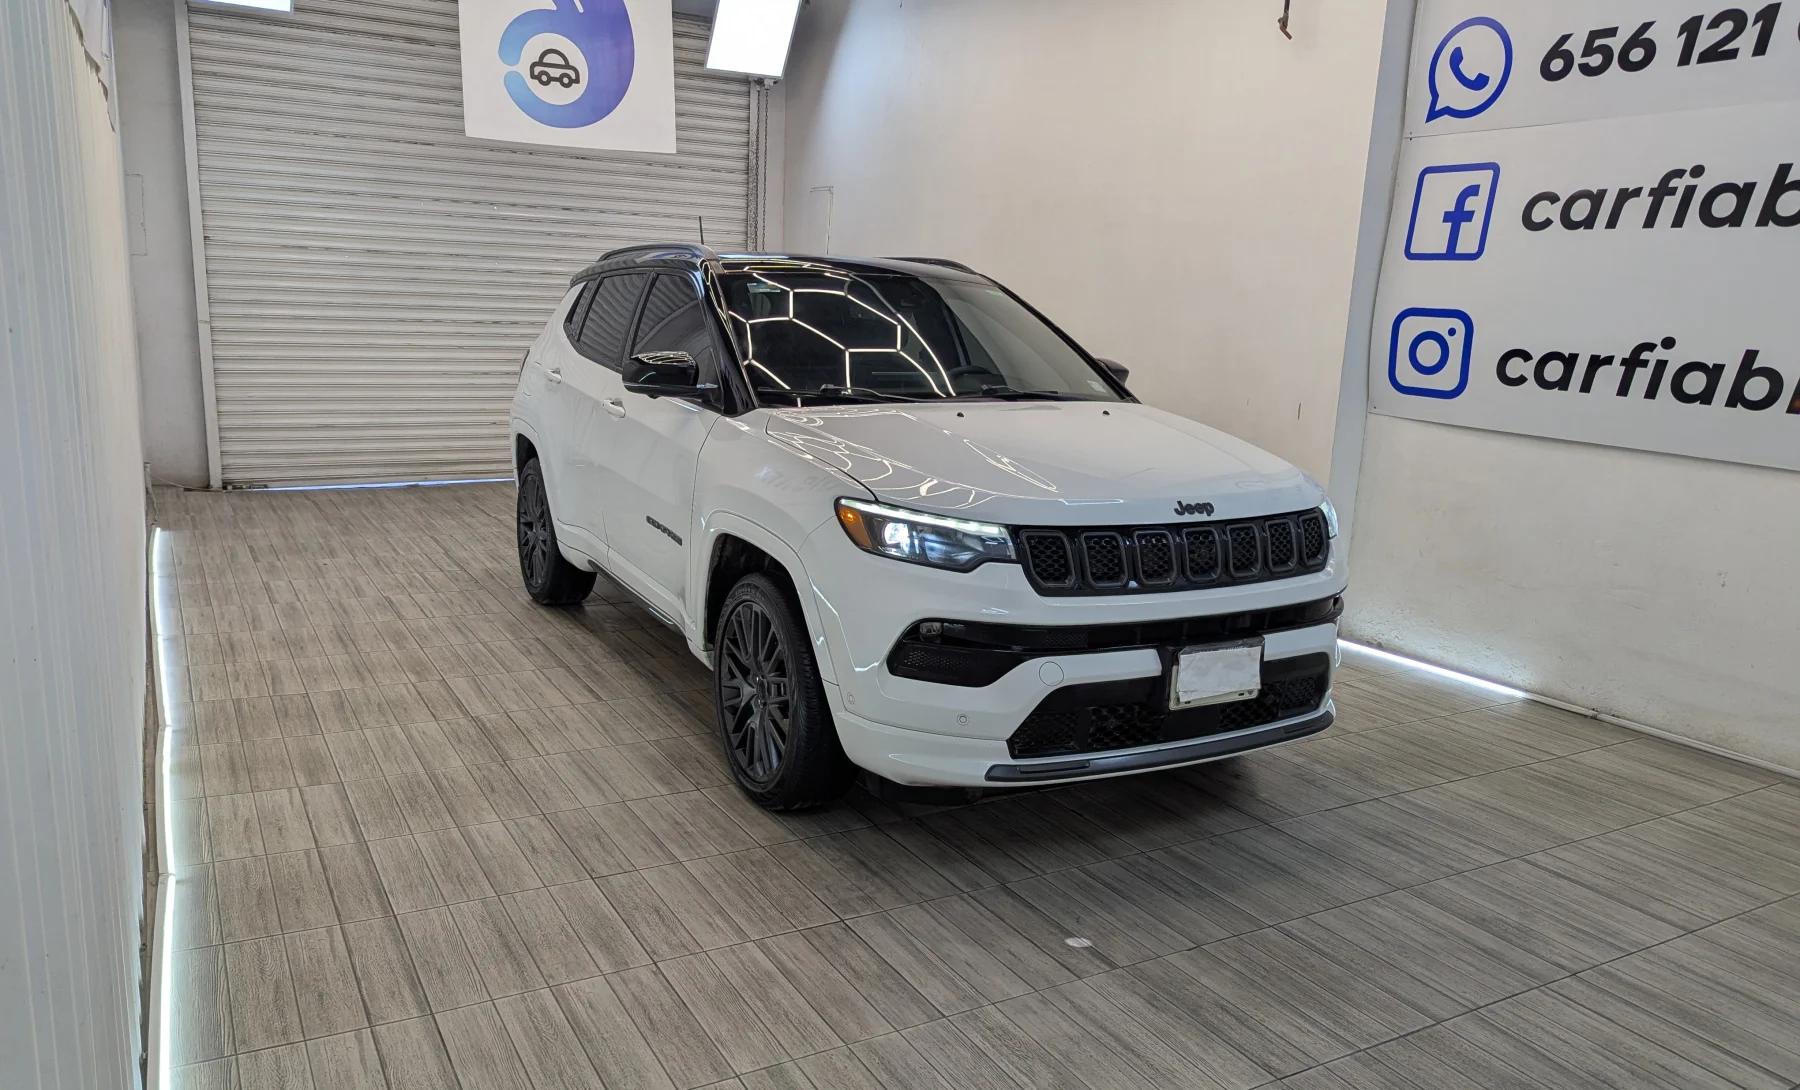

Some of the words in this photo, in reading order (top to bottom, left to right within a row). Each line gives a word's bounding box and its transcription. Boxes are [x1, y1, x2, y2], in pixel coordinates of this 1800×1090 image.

[1540, 21, 1657, 82] 656
[1677, 2, 1783, 68] 121
[1173, 500, 1215, 517] Jeep
